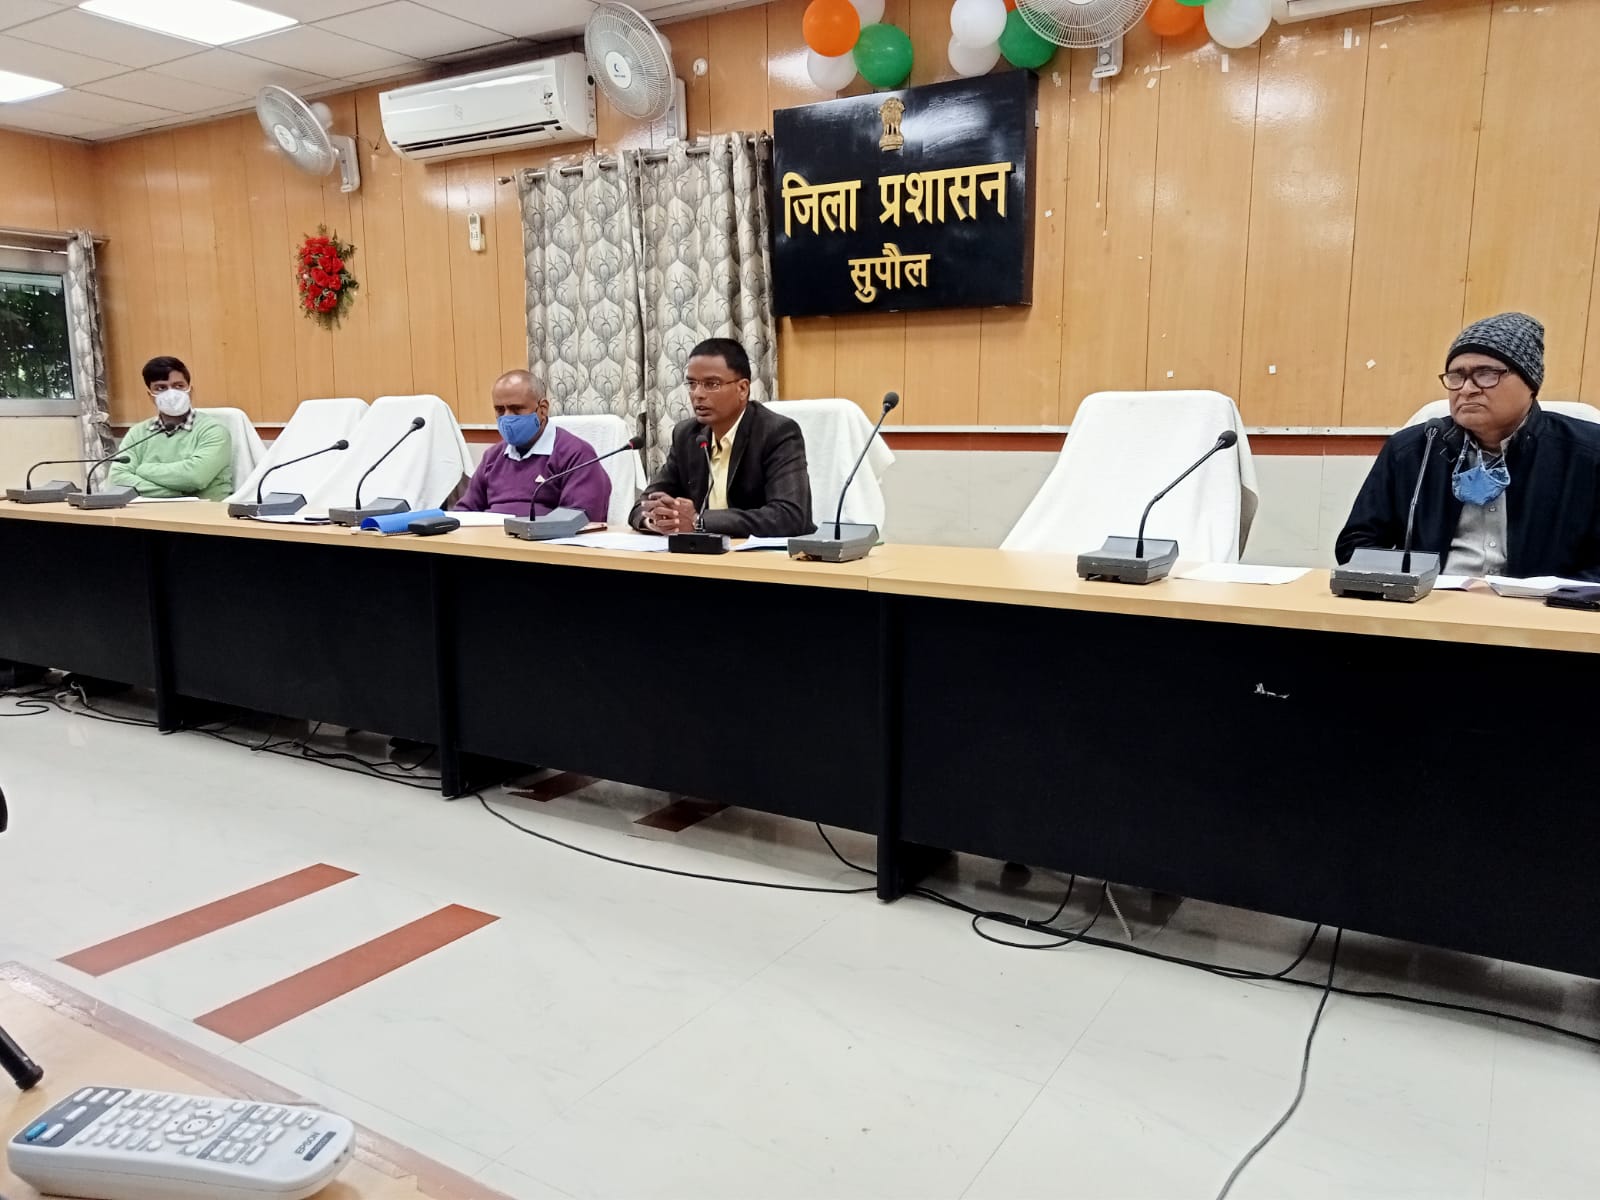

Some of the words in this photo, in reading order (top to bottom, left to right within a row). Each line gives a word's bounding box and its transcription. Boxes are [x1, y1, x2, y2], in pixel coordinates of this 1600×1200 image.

[781, 171, 861, 237] जिला
[878, 161, 1012, 226] प्रशासन
[848, 242, 931, 303] सुपौल
[294, 1131, 321, 1154] EPSON
